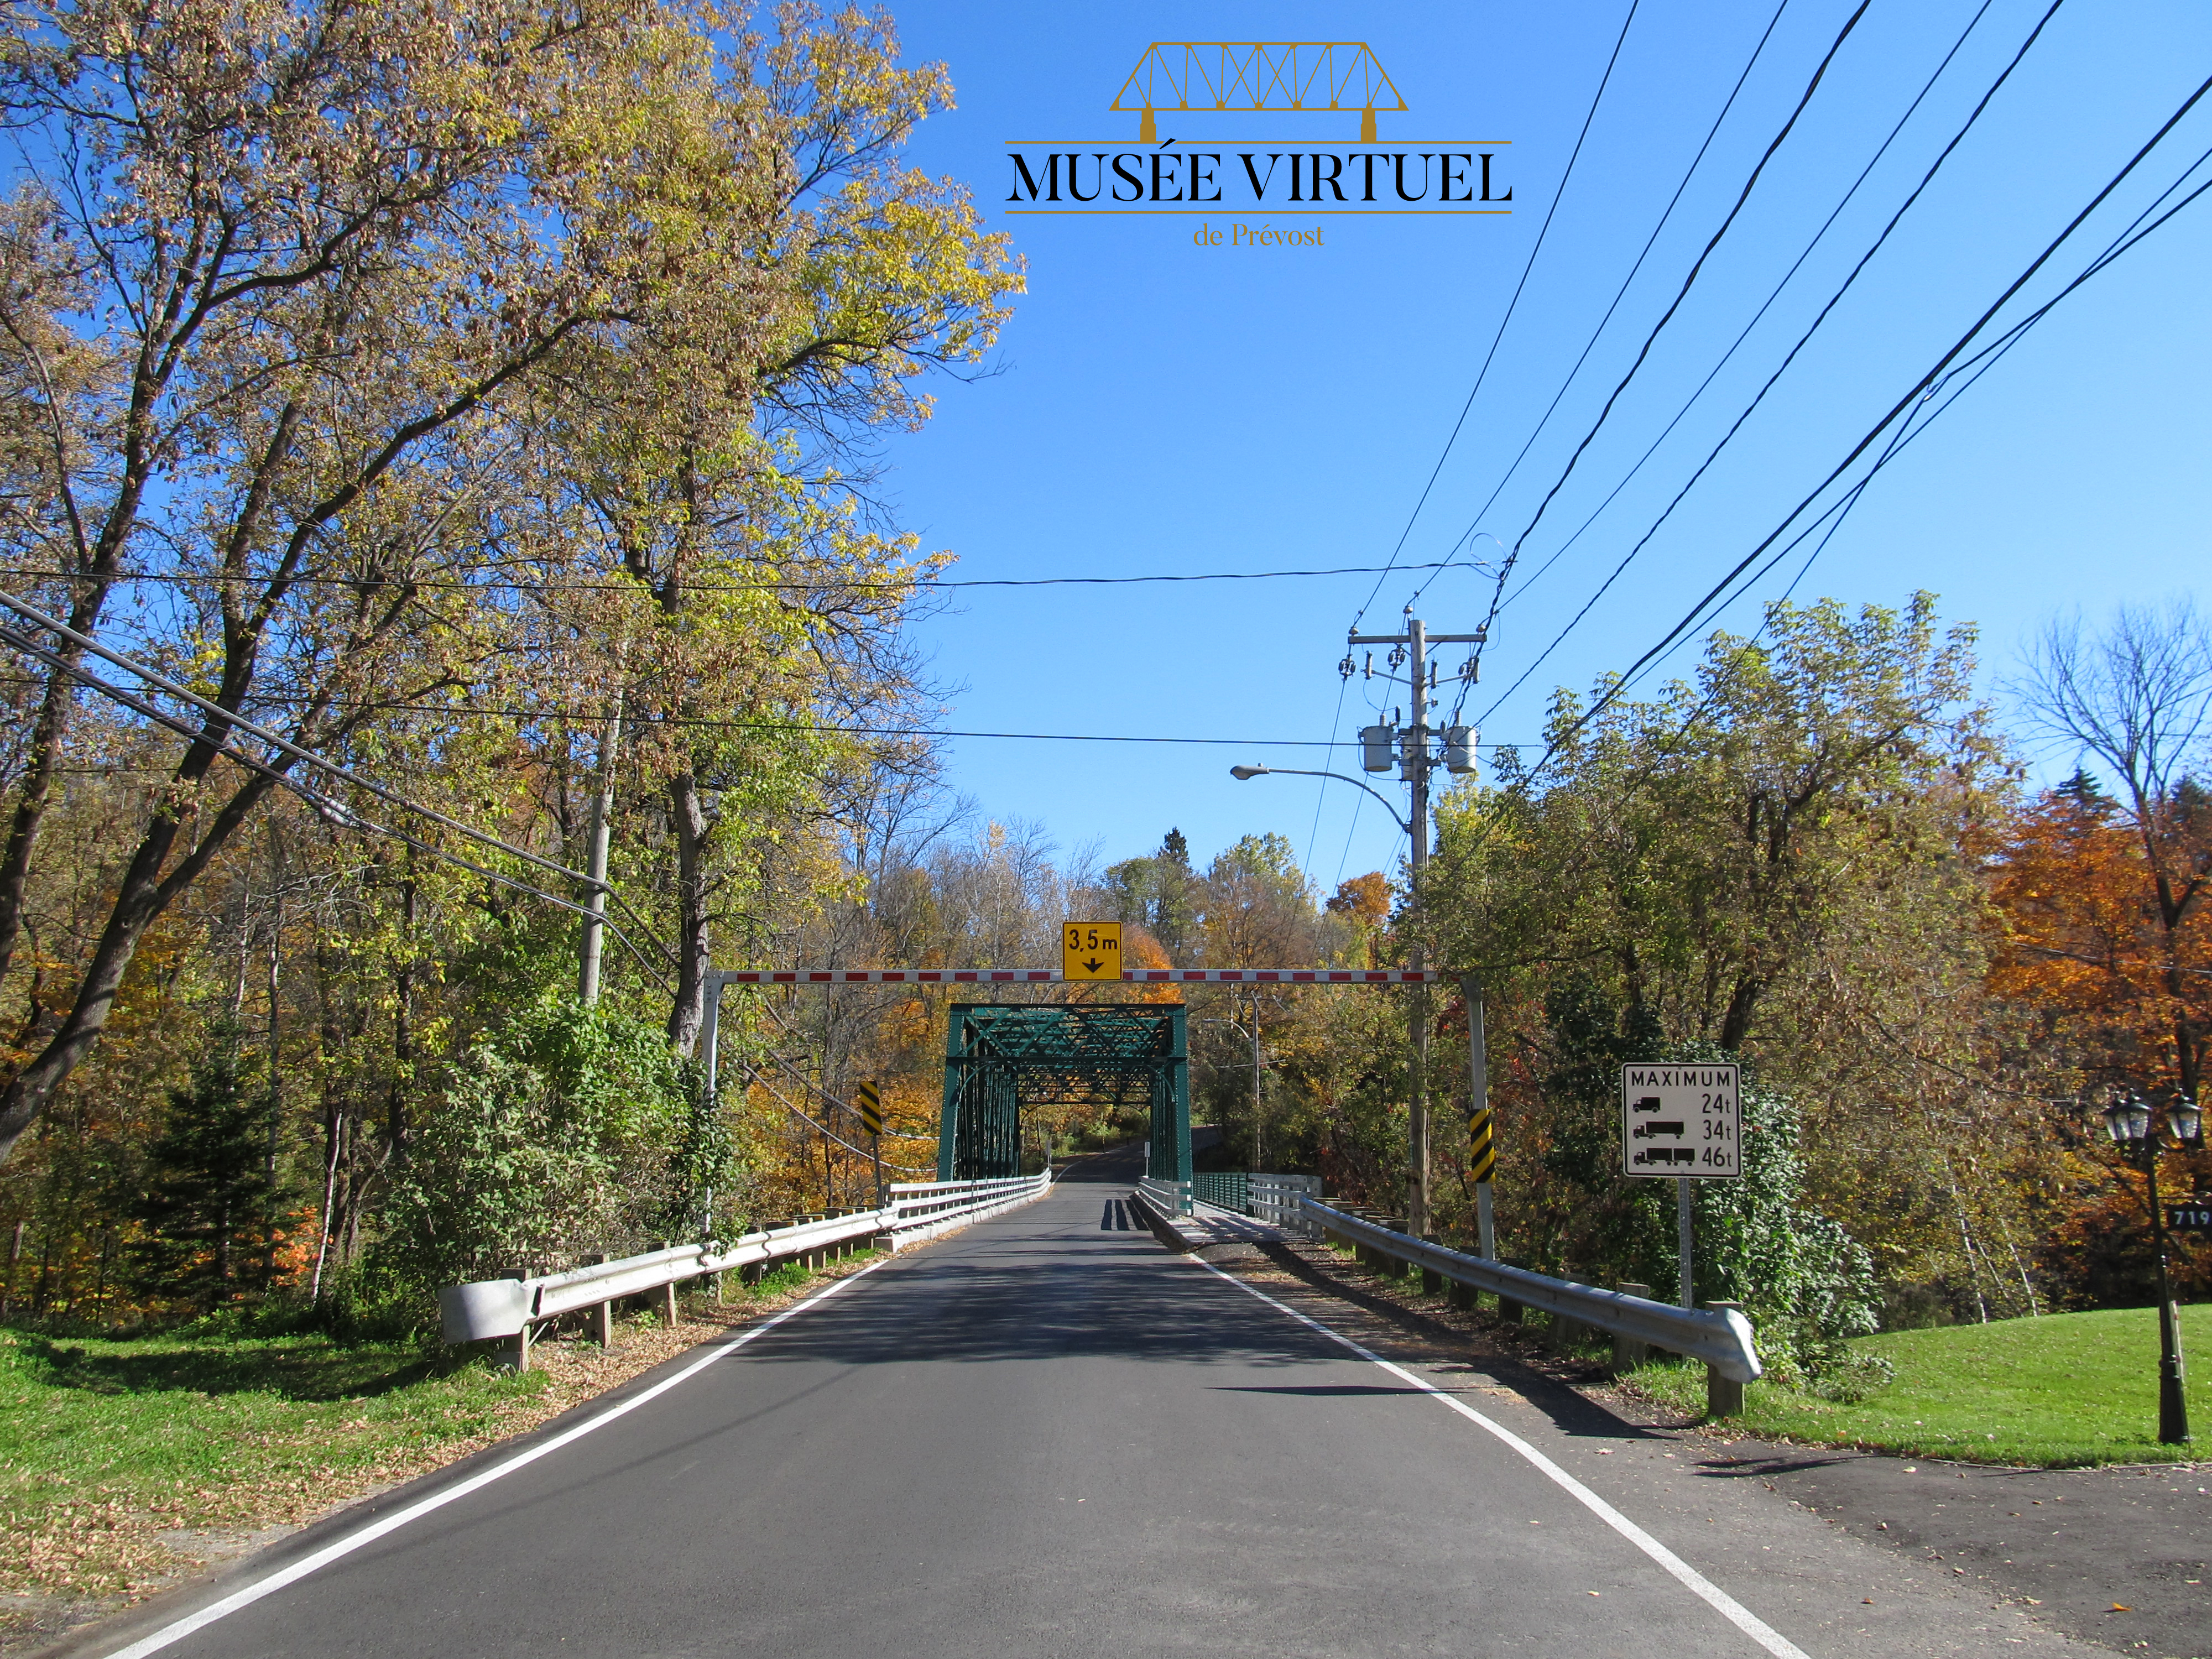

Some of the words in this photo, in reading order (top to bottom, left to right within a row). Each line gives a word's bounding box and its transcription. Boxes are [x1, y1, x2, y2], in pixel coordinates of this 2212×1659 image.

[1631, 1071, 1730, 1087] MAXIMUM
[1702, 1093, 1730, 1114] 24t
[1703, 1119, 1731, 1140] 34t
[1702, 1146, 1732, 1167] 46t
[2174, 1211, 2210, 1225] 719
